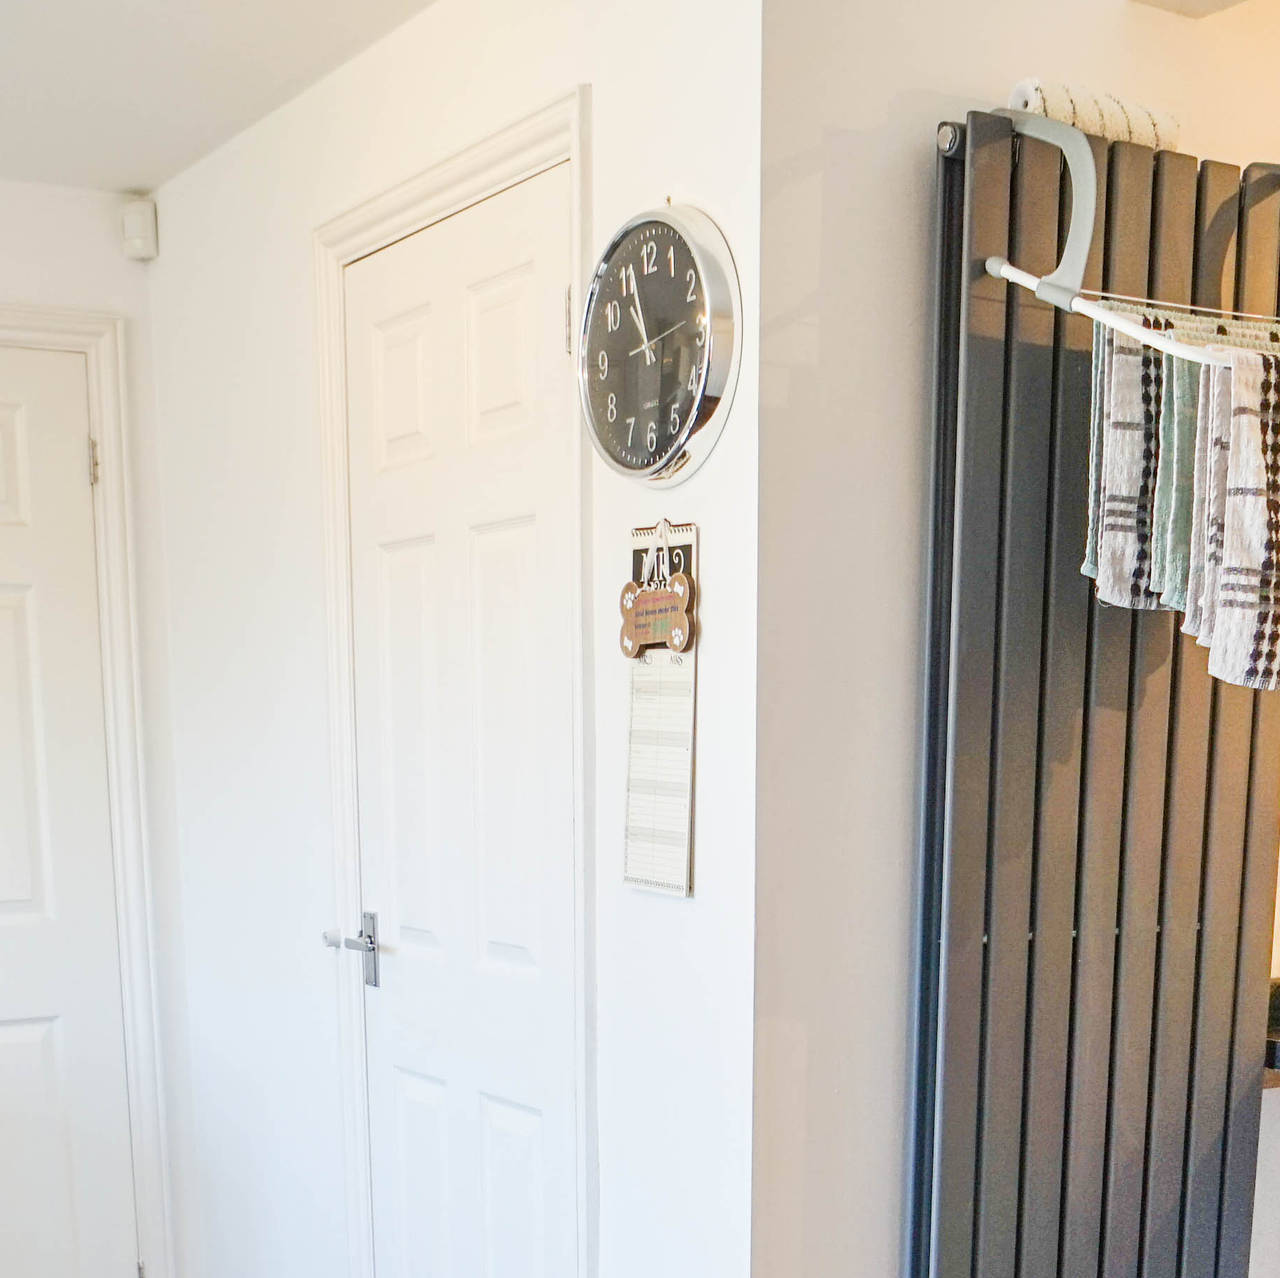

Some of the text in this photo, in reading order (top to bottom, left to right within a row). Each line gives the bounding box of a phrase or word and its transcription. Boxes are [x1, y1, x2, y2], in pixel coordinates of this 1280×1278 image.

[640, 241, 658, 276] 12
[667, 245, 675, 278] 1
[619, 263, 634, 297] 11
[686, 268, 697, 303] 2
[604, 300, 620, 333] 10
[696, 312, 707, 347] 3
[598, 350, 609, 380] 9
[687, 364, 698, 397] 4
[607, 393, 617, 423] 8
[670, 403, 680, 435] 5
[626, 416, 636, 447] 7
[647, 421, 657, 452] 6
